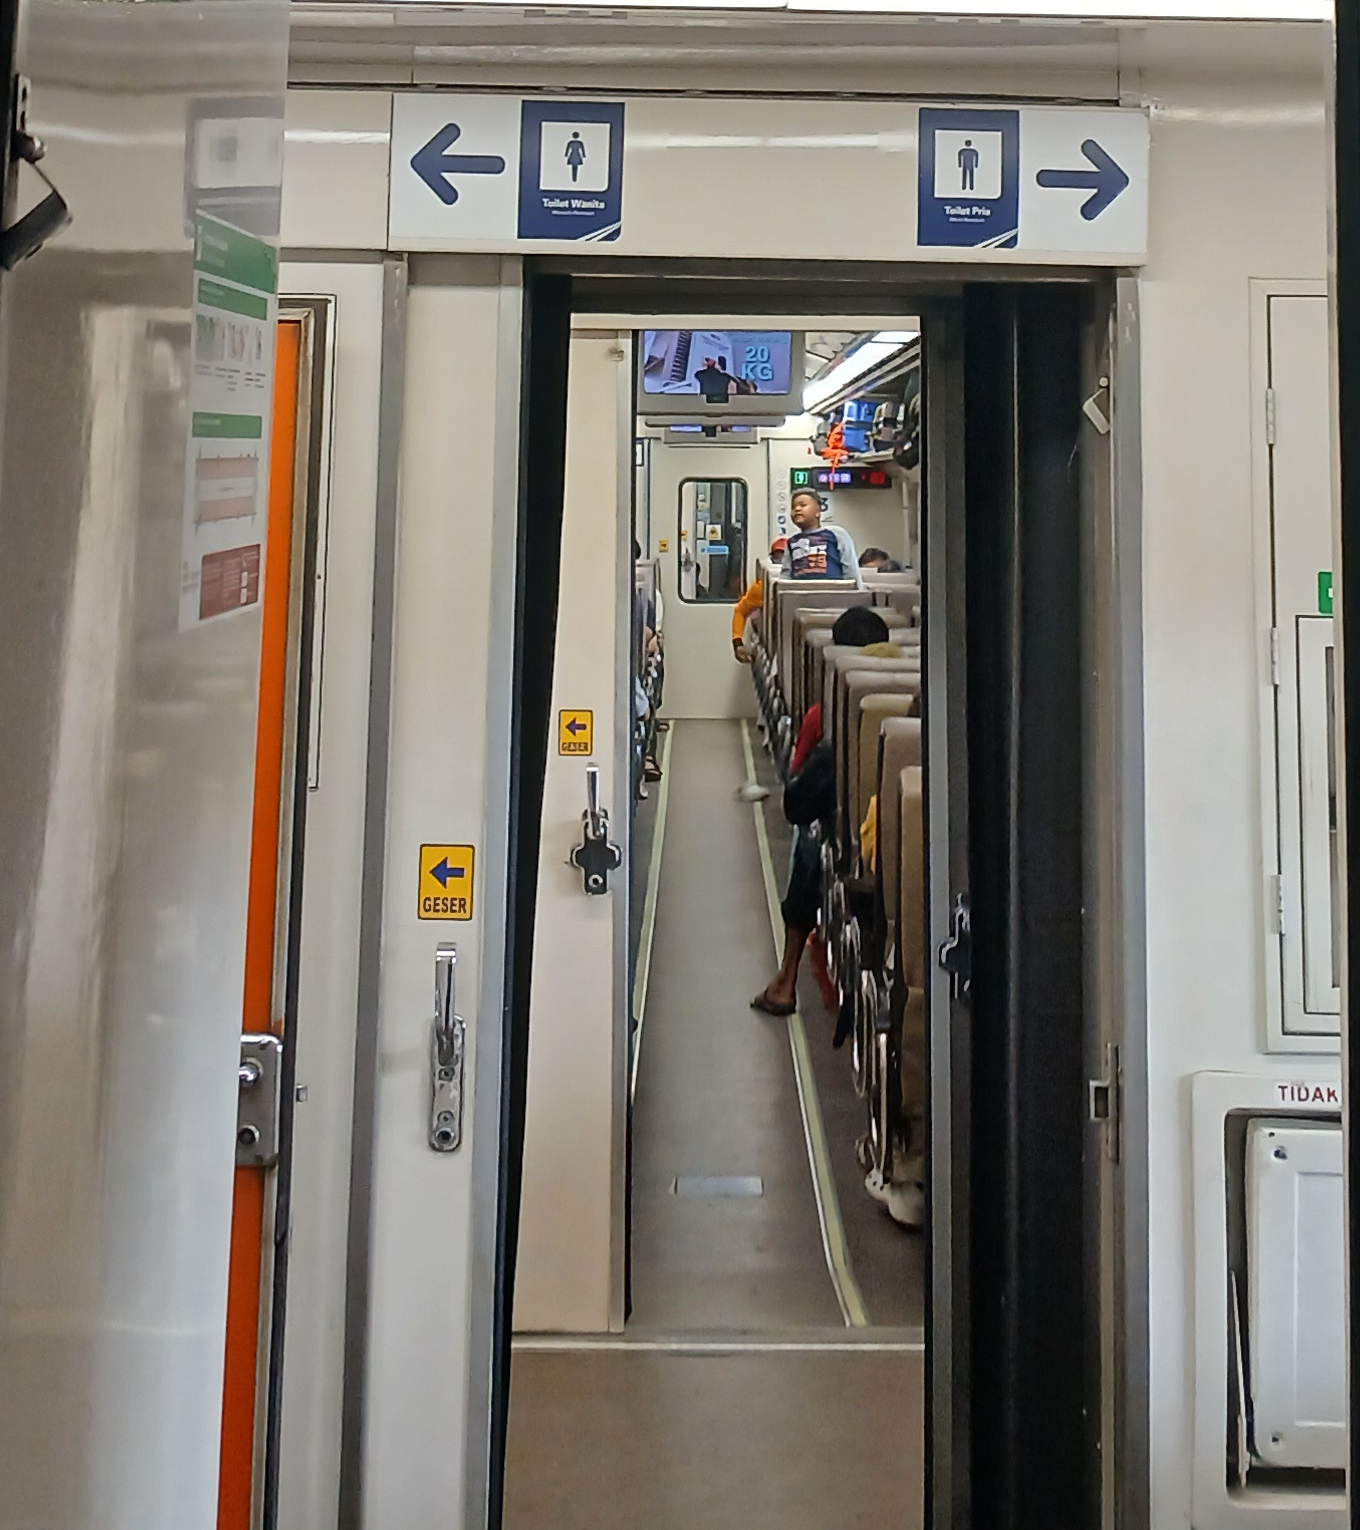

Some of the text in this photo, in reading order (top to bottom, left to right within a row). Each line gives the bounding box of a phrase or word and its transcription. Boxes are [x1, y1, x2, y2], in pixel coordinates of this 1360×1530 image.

[542, 198, 606, 209] Toilet Wanita
[944, 206, 991, 216] Toilet Pria
[745, 346, 770, 362] 20
[741, 363, 773, 380] KG
[561, 741, 589, 752] GESER
[423, 896, 467, 914] GESER
[1278, 1085, 1338, 1102] TIDAK
